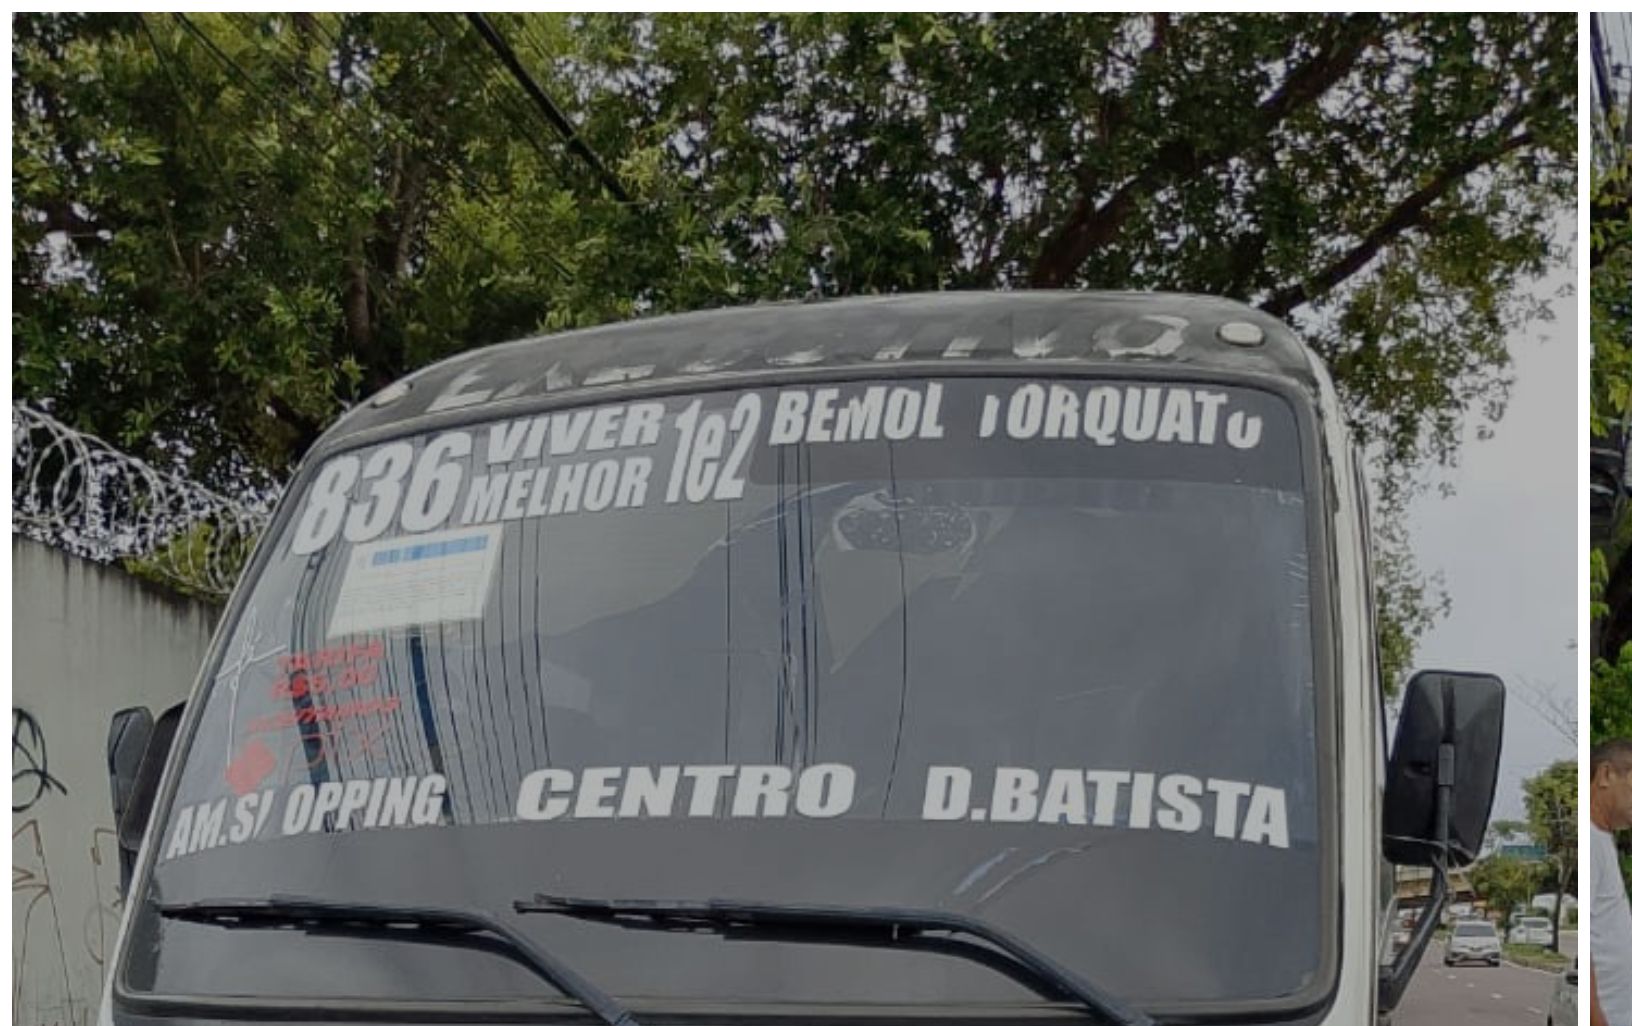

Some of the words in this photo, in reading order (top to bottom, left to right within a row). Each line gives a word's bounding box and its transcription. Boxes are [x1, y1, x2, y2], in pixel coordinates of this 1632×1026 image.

[484, 403, 666, 464] VIVER
[664, 392, 762, 504] 1e2
[769, 381, 943, 445] BEMOL
[292, 433, 471, 556] 836
[461, 455, 654, 524] MELHOR
[515, 763, 855, 821] CENTRO
[923, 764, 1290, 849] D.BATISTA
